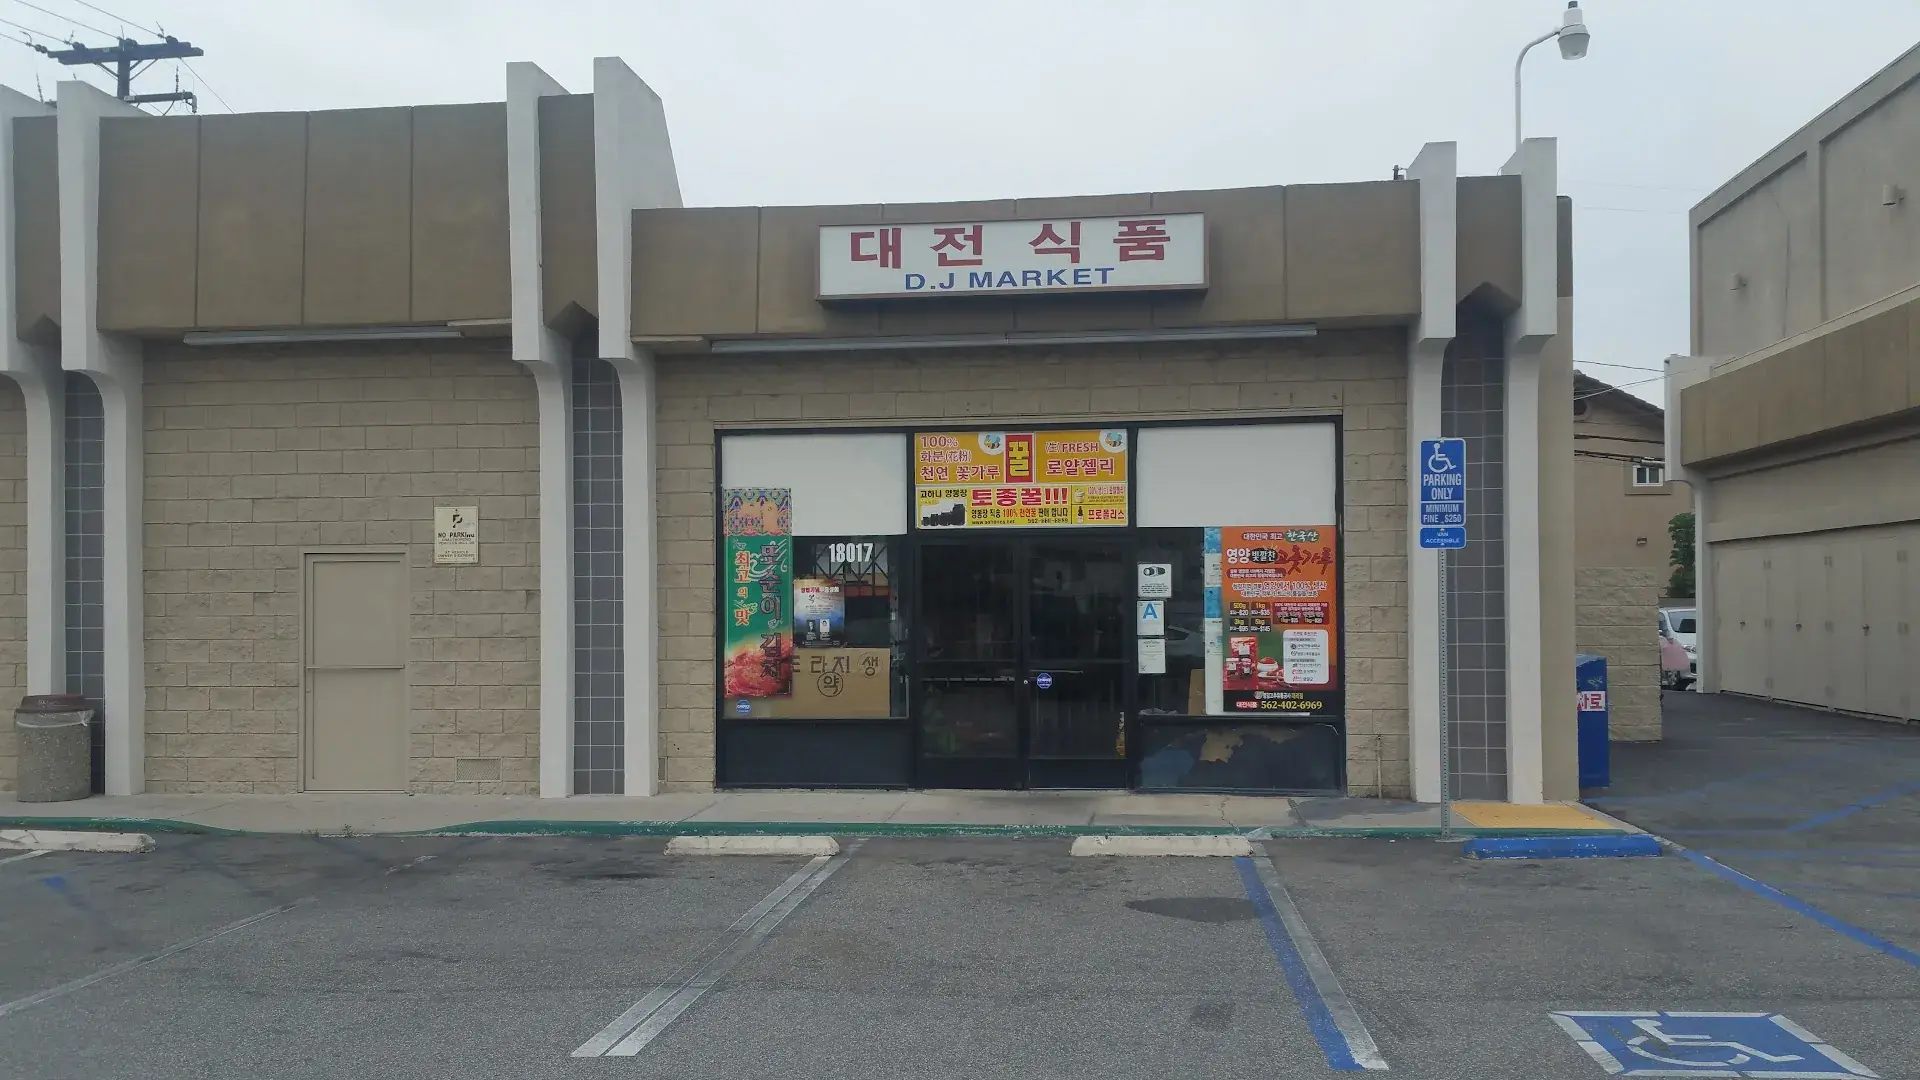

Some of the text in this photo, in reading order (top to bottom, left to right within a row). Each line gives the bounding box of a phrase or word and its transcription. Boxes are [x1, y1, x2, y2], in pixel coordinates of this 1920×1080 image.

[905, 267, 1115, 290] D.J MARKET
[921, 436, 958, 447] 100%
[1008, 441, 1029, 477] 꿀
[921, 465, 1000, 481] 천연 꽃가루
[1046, 458, 1114, 476] 로얄젤리
[1423, 474, 1462, 486] PARKING
[945, 488, 967, 498] 양봉장
[971, 487, 1068, 506] 토종꿀!!!
[1431, 488, 1454, 500] ONLY
[1003, 508, 1018, 518] 100%
[1019, 508, 1036, 517] 천연꿀
[1038, 508, 1050, 517] 판매
[1051, 507, 1068, 517] 합니다
[1088, 509, 1125, 520] 프로폴리스
[1425, 504, 1459, 513] MINIMUM
[1423, 514, 1461, 523] FINE $250
[1286, 530, 1319, 541] 한국산
[828, 543, 873, 563] 18017
[1226, 548, 1251, 564] 영양
[1292, 581, 1312, 590] 100%
[1313, 581, 1327, 590] 생산
[734, 608, 751, 626] 맛
[1142, 603, 1158, 619] A
[760, 632, 781, 679] 김치
[820, 674, 841, 696] 약
[1261, 701, 1323, 709] 562-402-6969
